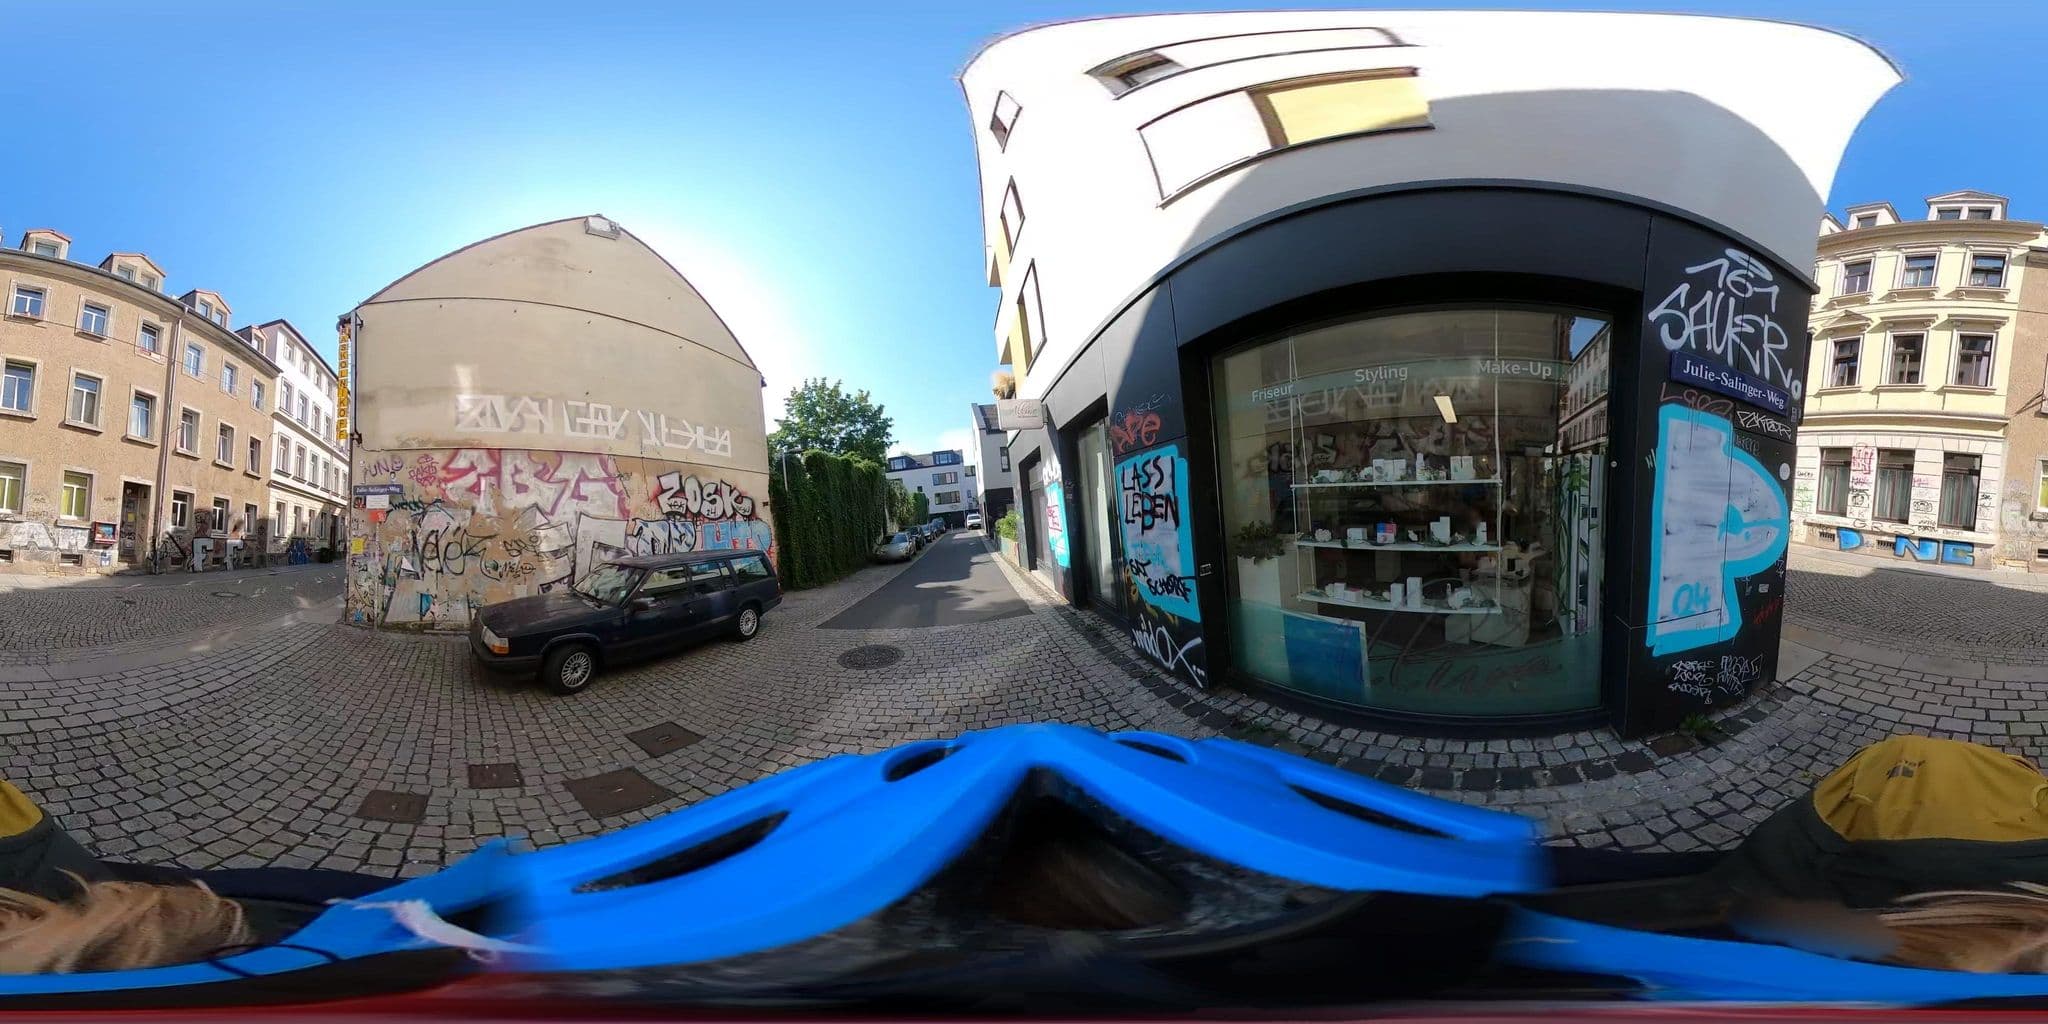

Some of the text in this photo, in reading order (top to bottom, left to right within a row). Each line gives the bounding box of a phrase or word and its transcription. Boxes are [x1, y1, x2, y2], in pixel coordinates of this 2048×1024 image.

[1252, 359, 1552, 402] Friseur Styling Make-Up
[1683, 359, 1785, 409] Julie-Salinger-Weg
[1124, 491, 1181, 536] LEBEN
